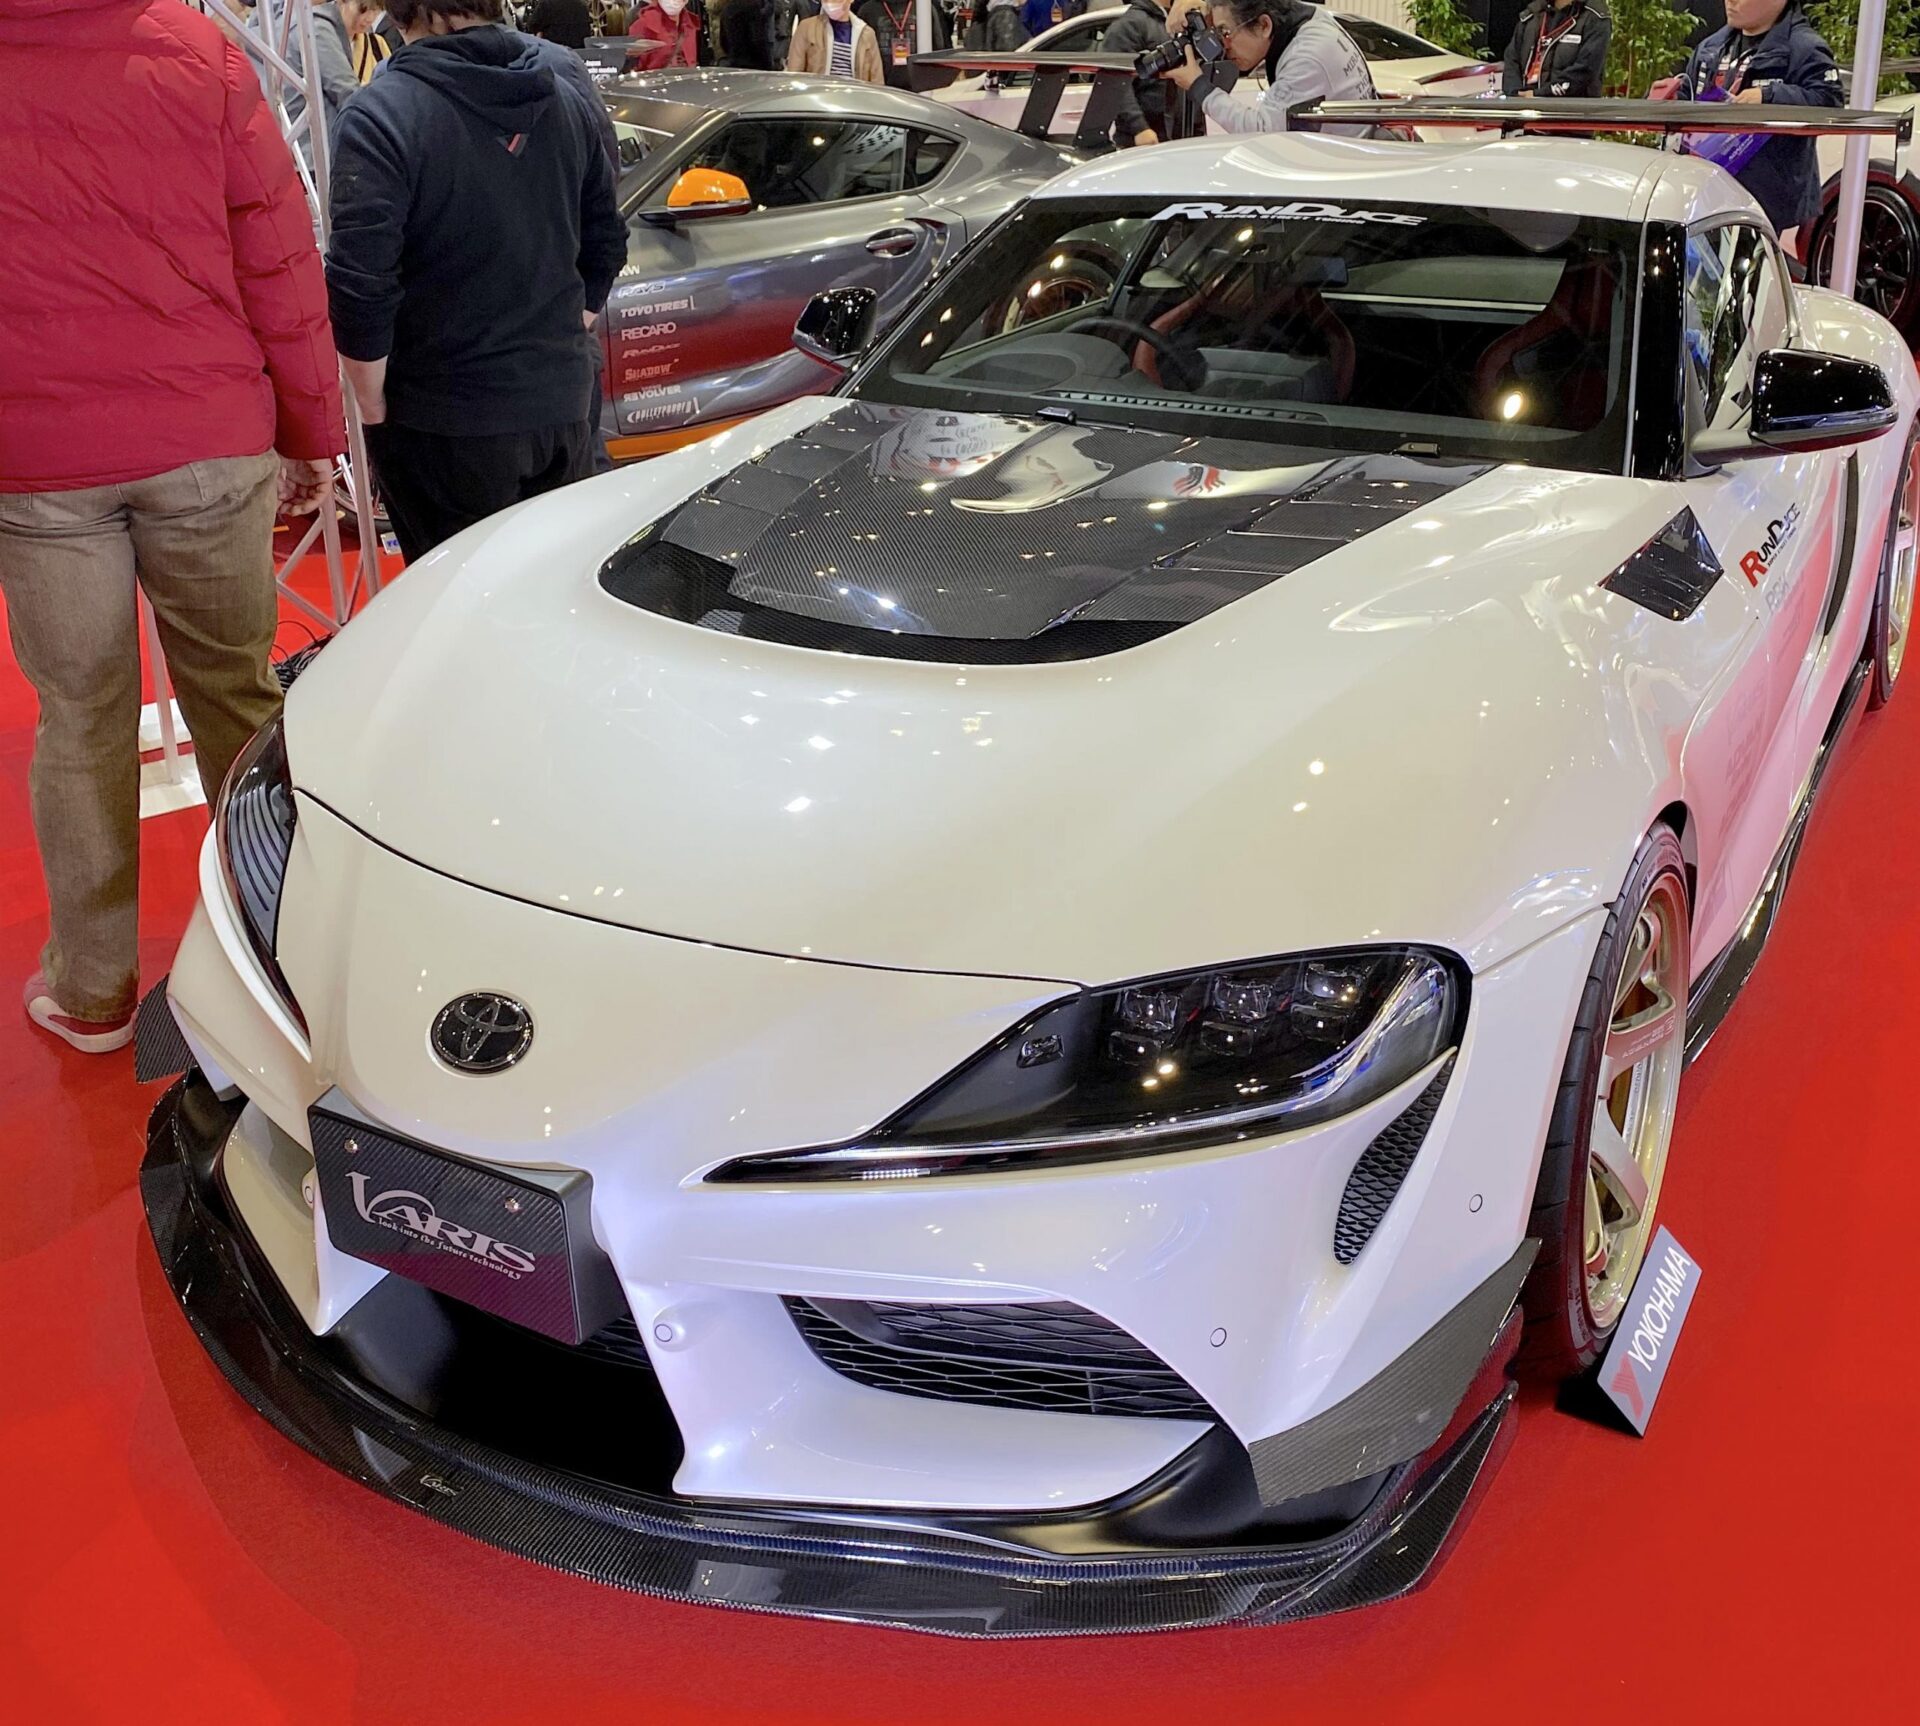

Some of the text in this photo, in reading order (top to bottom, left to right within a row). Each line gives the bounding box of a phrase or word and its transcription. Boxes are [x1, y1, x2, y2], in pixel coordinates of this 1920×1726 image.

[620, 299, 689, 319] TOYO TIRES
[621, 321, 677, 341] RECARO
[624, 363, 673, 382] SHADOW
[623, 384, 681, 402] REVOLVER
[345, 1171, 536, 1273] VARIS
[378, 1217, 521, 1280] look into the future technology
[1627, 1246, 1691, 1373] YOKOHAMA
